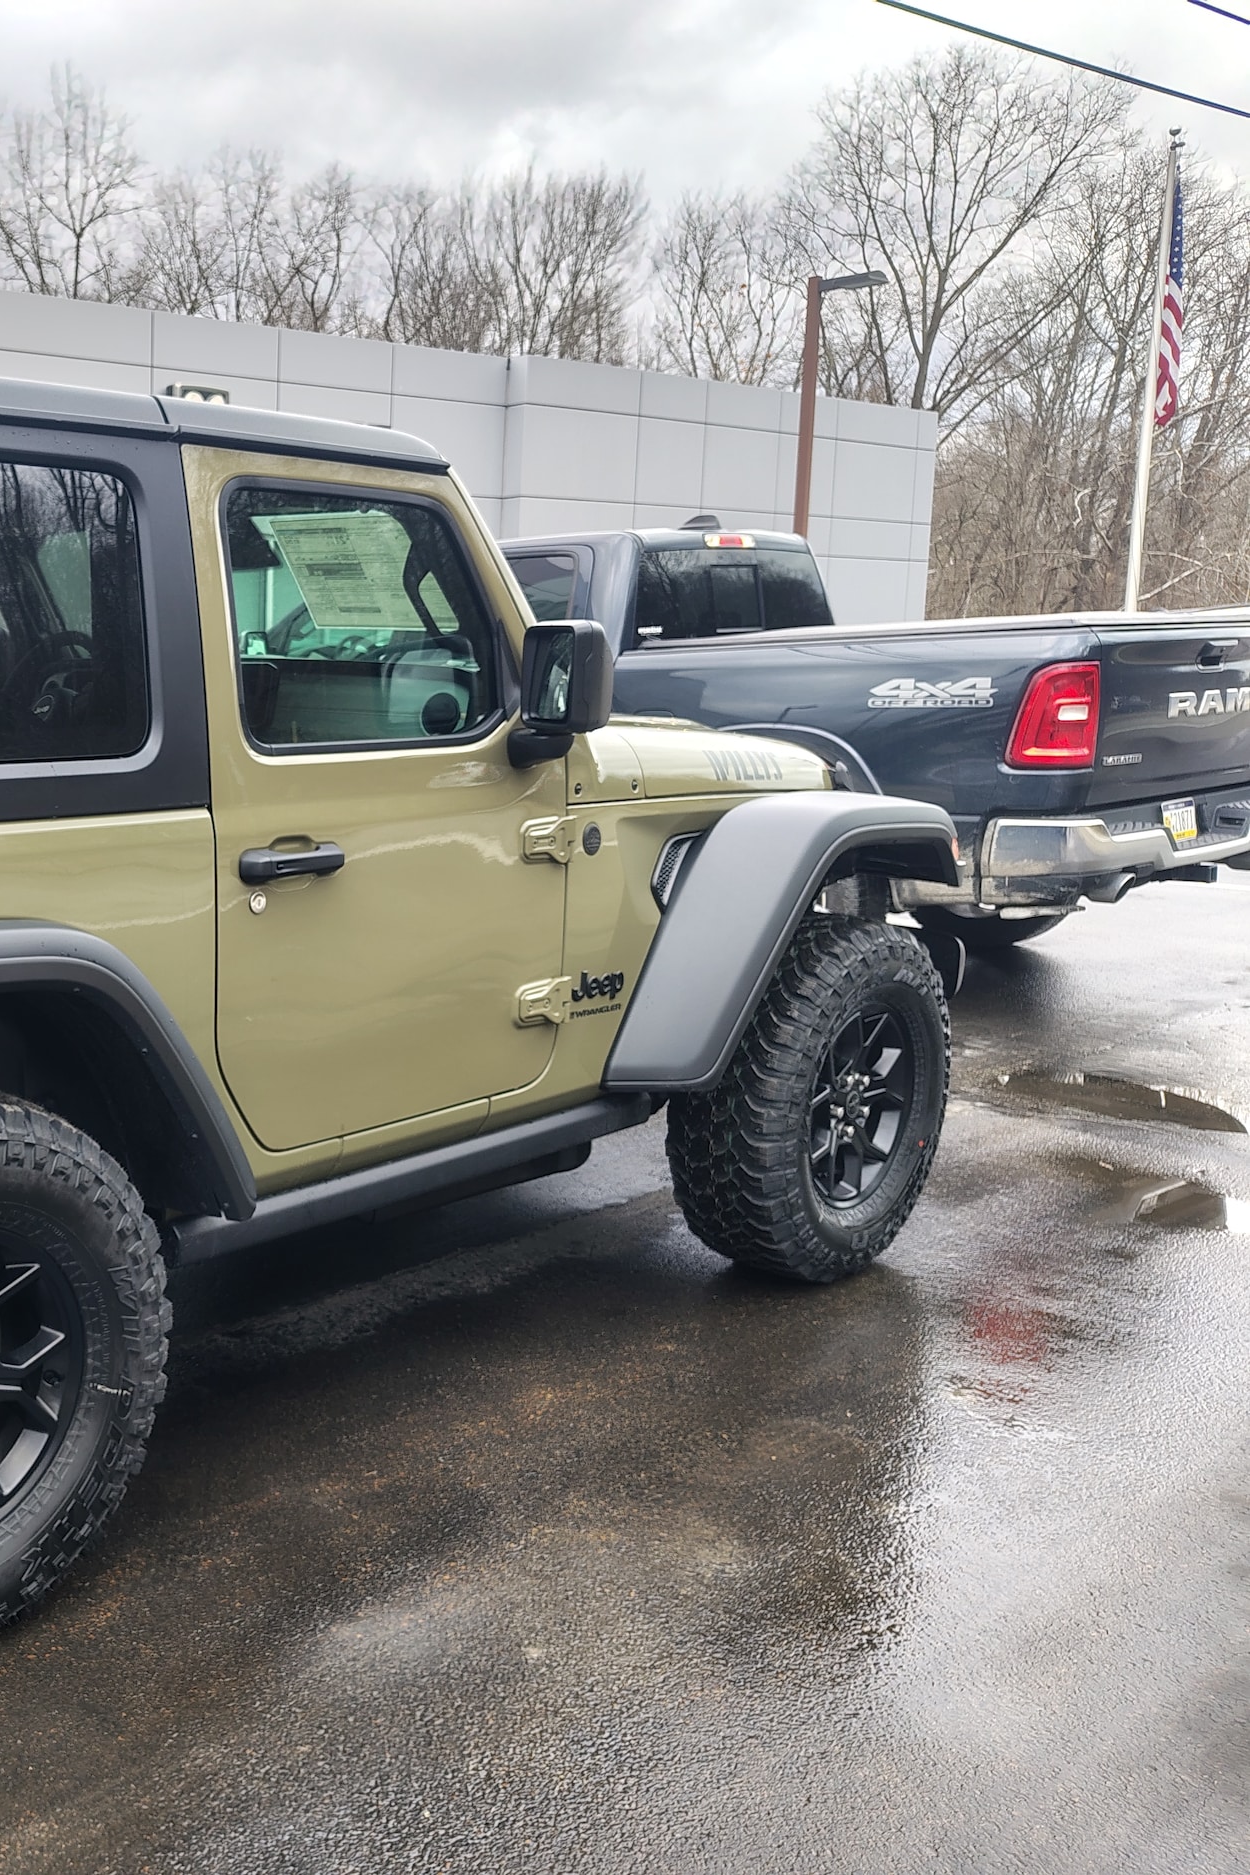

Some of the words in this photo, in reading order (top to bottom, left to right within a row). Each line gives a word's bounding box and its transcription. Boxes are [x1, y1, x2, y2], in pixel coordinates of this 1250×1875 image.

[871, 698, 919, 707] OFF
[922, 698, 991, 707] ROAD
[1168, 686, 1250, 719] RAM
[704, 749, 784, 781] WILLYS
[571, 969, 625, 1002] Jeep
[574, 1003, 622, 1019] WRANGLER
